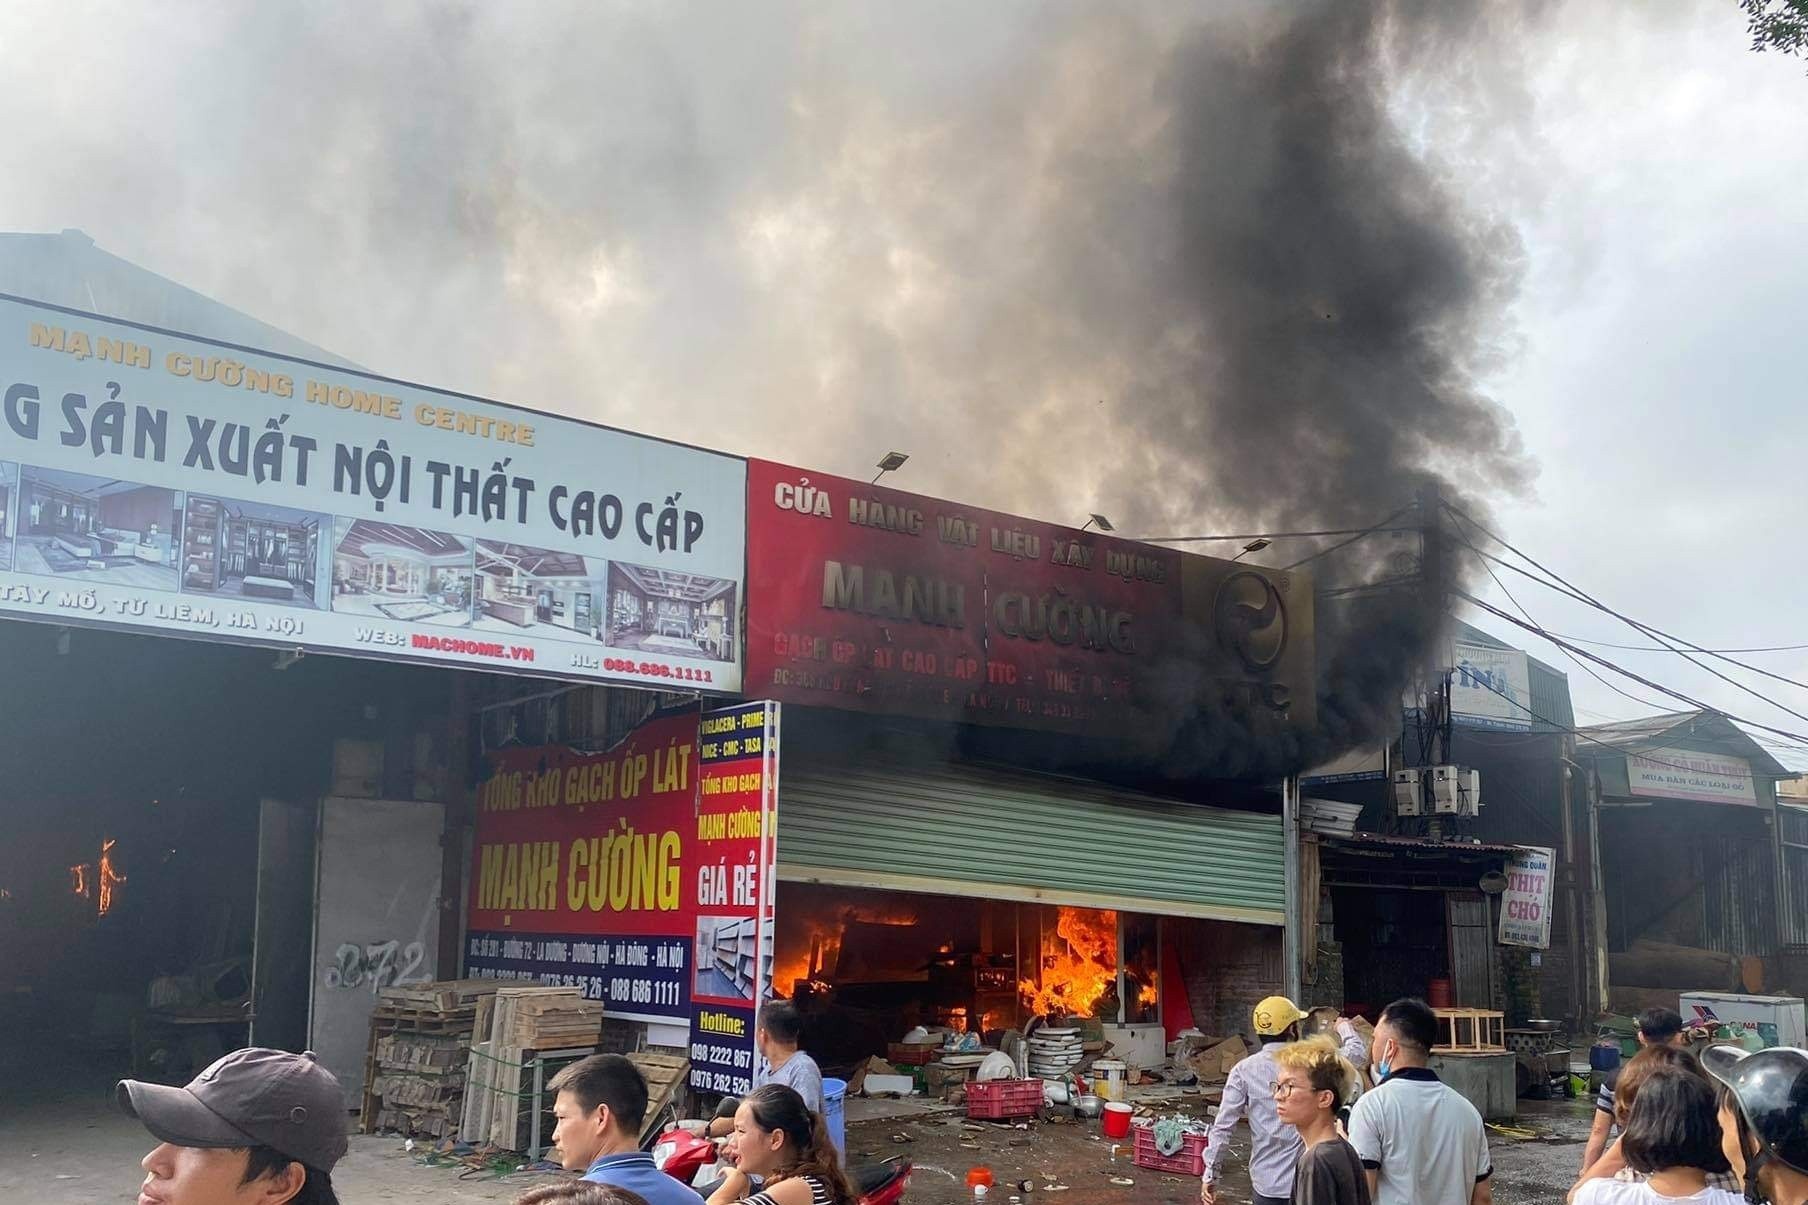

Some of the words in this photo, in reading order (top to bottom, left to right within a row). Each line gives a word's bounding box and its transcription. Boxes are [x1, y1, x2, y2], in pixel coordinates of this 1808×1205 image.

[29, 321, 151, 368] MẠNH
[165, 352, 294, 398] CƯỜNG
[306, 379, 402, 419] HOME
[415, 403, 535, 446] CENTRE
[3, 382, 40, 441] G
[59, 381, 168, 462] SẢN
[183, 414, 317, 486] XUẤT
[333, 439, 411, 512] NỘI
[426, 457, 535, 524] THẤT
[548, 485, 623, 540] CAO
[635, 491, 704, 553] CẤP
[774, 477, 832, 518] CỬA
[848, 495, 923, 536] HÀNG
[937, 514, 979, 548] VẬT
[991, 526, 1040, 561] LIỆU
[1050, 539, 1095, 570] XÂY
[1105, 549, 1168, 584] DỰNG
[227, 610, 258, 630] HÀ
[265, 616, 305, 635] NỘI
[993, 584, 1136, 656] CƯỜNG
[354, 626, 406, 647] WEB:
[411, 634, 535, 662] MACHOME.VN
[741, 711, 764, 729] PRIME
[702, 743, 718, 759] NICE
[723, 740, 739, 757] CMC
[744, 737, 761, 753] TASA
[484, 761, 523, 812] TỔNG
[526, 768, 561, 808] KHO
[565, 761, 616, 812] GẠCH
[620, 742, 648, 799] ỐP
[653, 737, 691, 793] LÁT
[701, 771, 721, 796] TỔNG
[722, 774, 738, 793] KHO
[739, 773, 761, 795] GẠCH
[1642, 773, 1664, 783] MUA
[698, 813, 725, 846] MẠNH
[727, 805, 762, 840] CƯỜNG
[478, 841, 560, 926] MẠNH
[567, 817, 681, 912] CƯỜNG
[697, 856, 728, 906] GIÁ
[733, 850, 757, 906] RẺ
[1508, 871, 1545, 897] THỊT
[1508, 896, 1541, 921] CHÓ
[524, 941, 533, 960] 72
[597, 939, 610, 969] NỘI
[615, 941, 626, 966] HÀ
[656, 941, 668, 968] HÀ
[668, 941, 684, 974] NỘI
[590, 976, 602, 998] 26
[611, 977, 630, 1002] 088
[632, 978, 652, 1004] 686
[654, 980, 680, 1006] 1111
[700, 1011, 745, 1035] Hotline:
[691, 1043, 708, 1061] 098
[709, 1045, 732, 1065] 2222
[734, 1049, 751, 1069] 867
[690, 1069, 711, 1089] 0976
[713, 1073, 730, 1093] 262
[732, 1077, 750, 1095] 526
